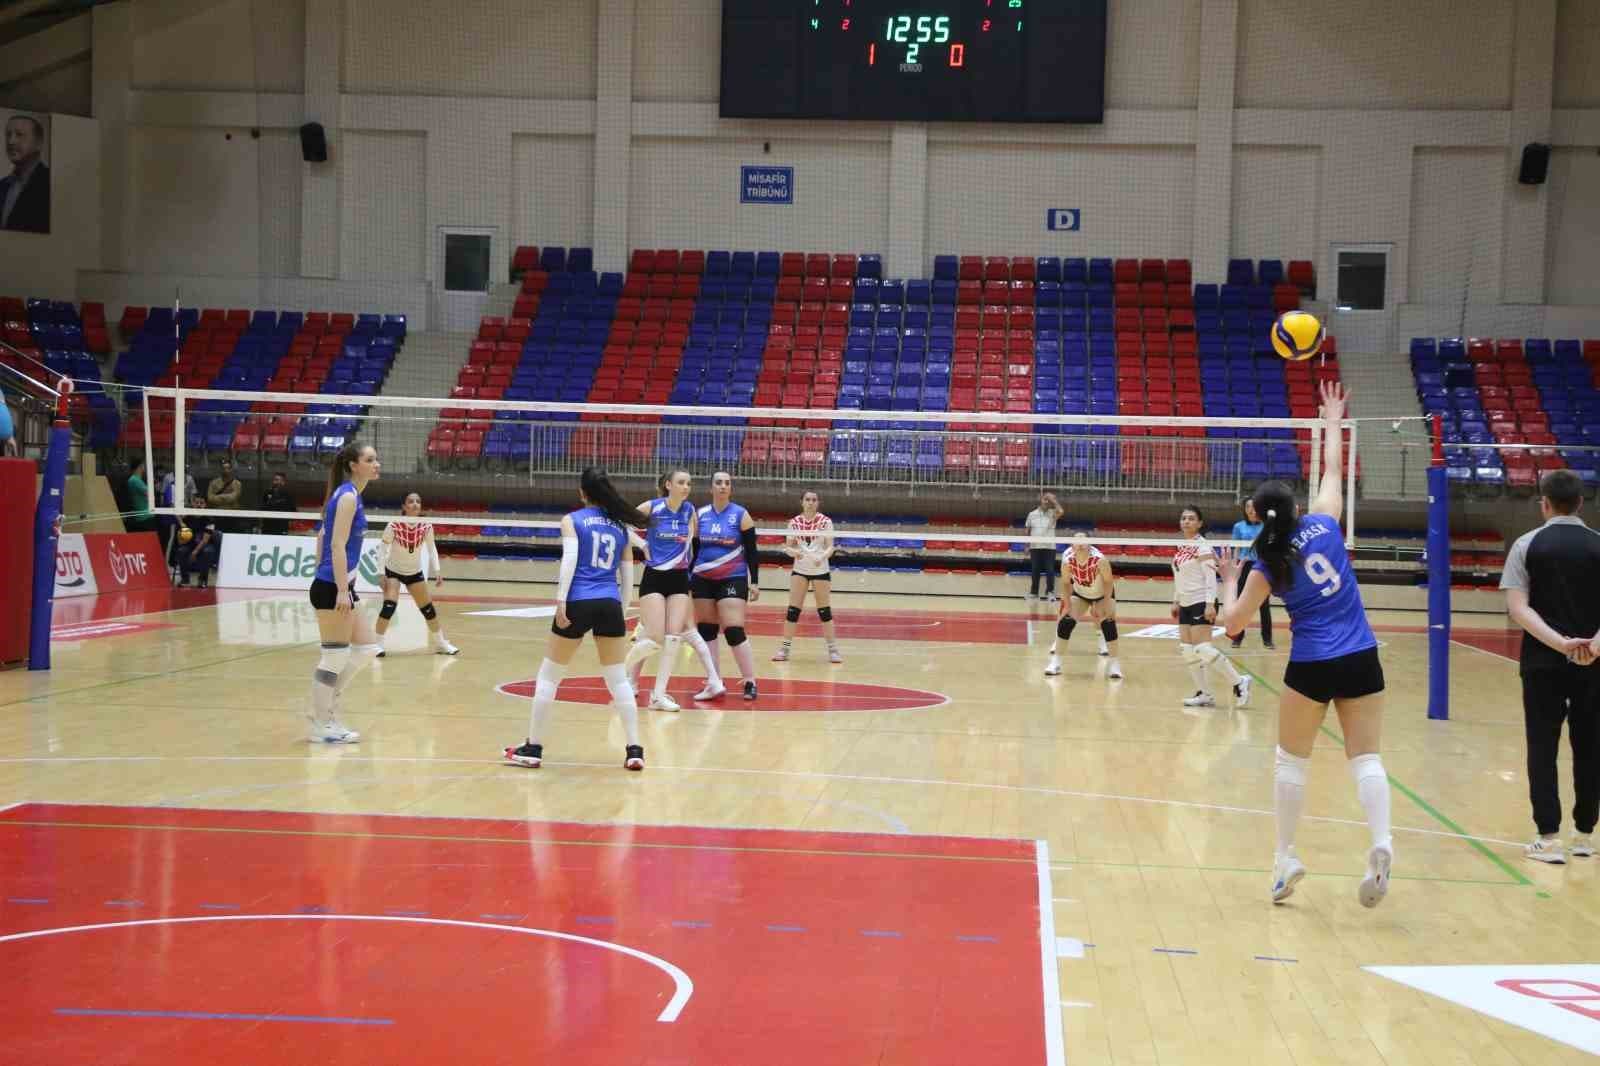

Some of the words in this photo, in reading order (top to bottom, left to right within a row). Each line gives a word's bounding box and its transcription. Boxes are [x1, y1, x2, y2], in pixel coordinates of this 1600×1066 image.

[811, 18, 818, 29] 4
[842, 19, 850, 30] 2
[982, 20, 990, 31] 2
[869, 43, 875, 65] 1
[906, 43, 919, 63] 2
[950, 44, 964, 66] 0
[1055, 210, 1074, 229] D
[592, 530, 616, 570] 13
[56, 551, 83, 576] OTO
[125, 554, 147, 575] TVF
[247, 545, 318, 577] idda
[1304, 553, 1342, 597] 9
